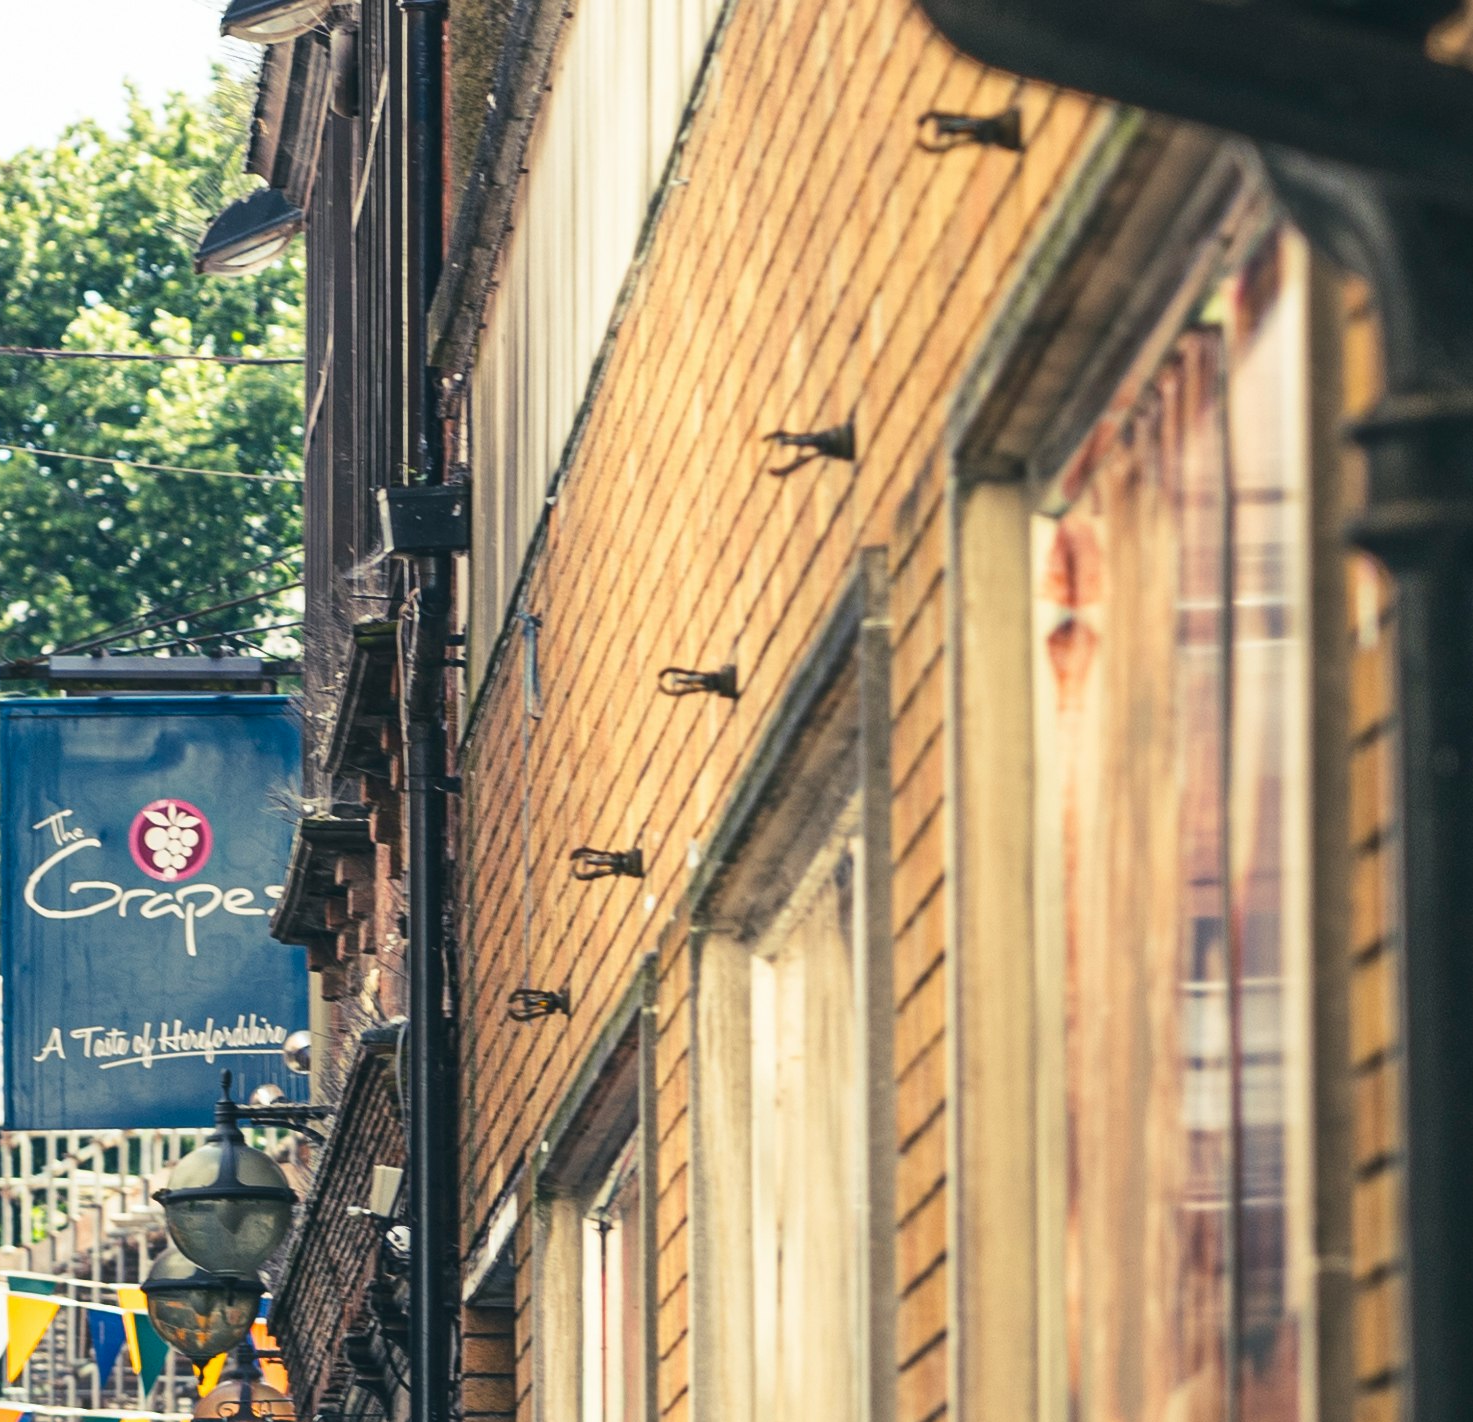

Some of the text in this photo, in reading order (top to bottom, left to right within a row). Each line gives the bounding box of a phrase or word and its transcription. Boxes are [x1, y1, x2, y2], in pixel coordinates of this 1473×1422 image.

[32, 808, 85, 846] The
[32, 1027, 66, 1063] A
[70, 1026, 130, 1060] Taste
[132, 1021, 157, 1069] of
